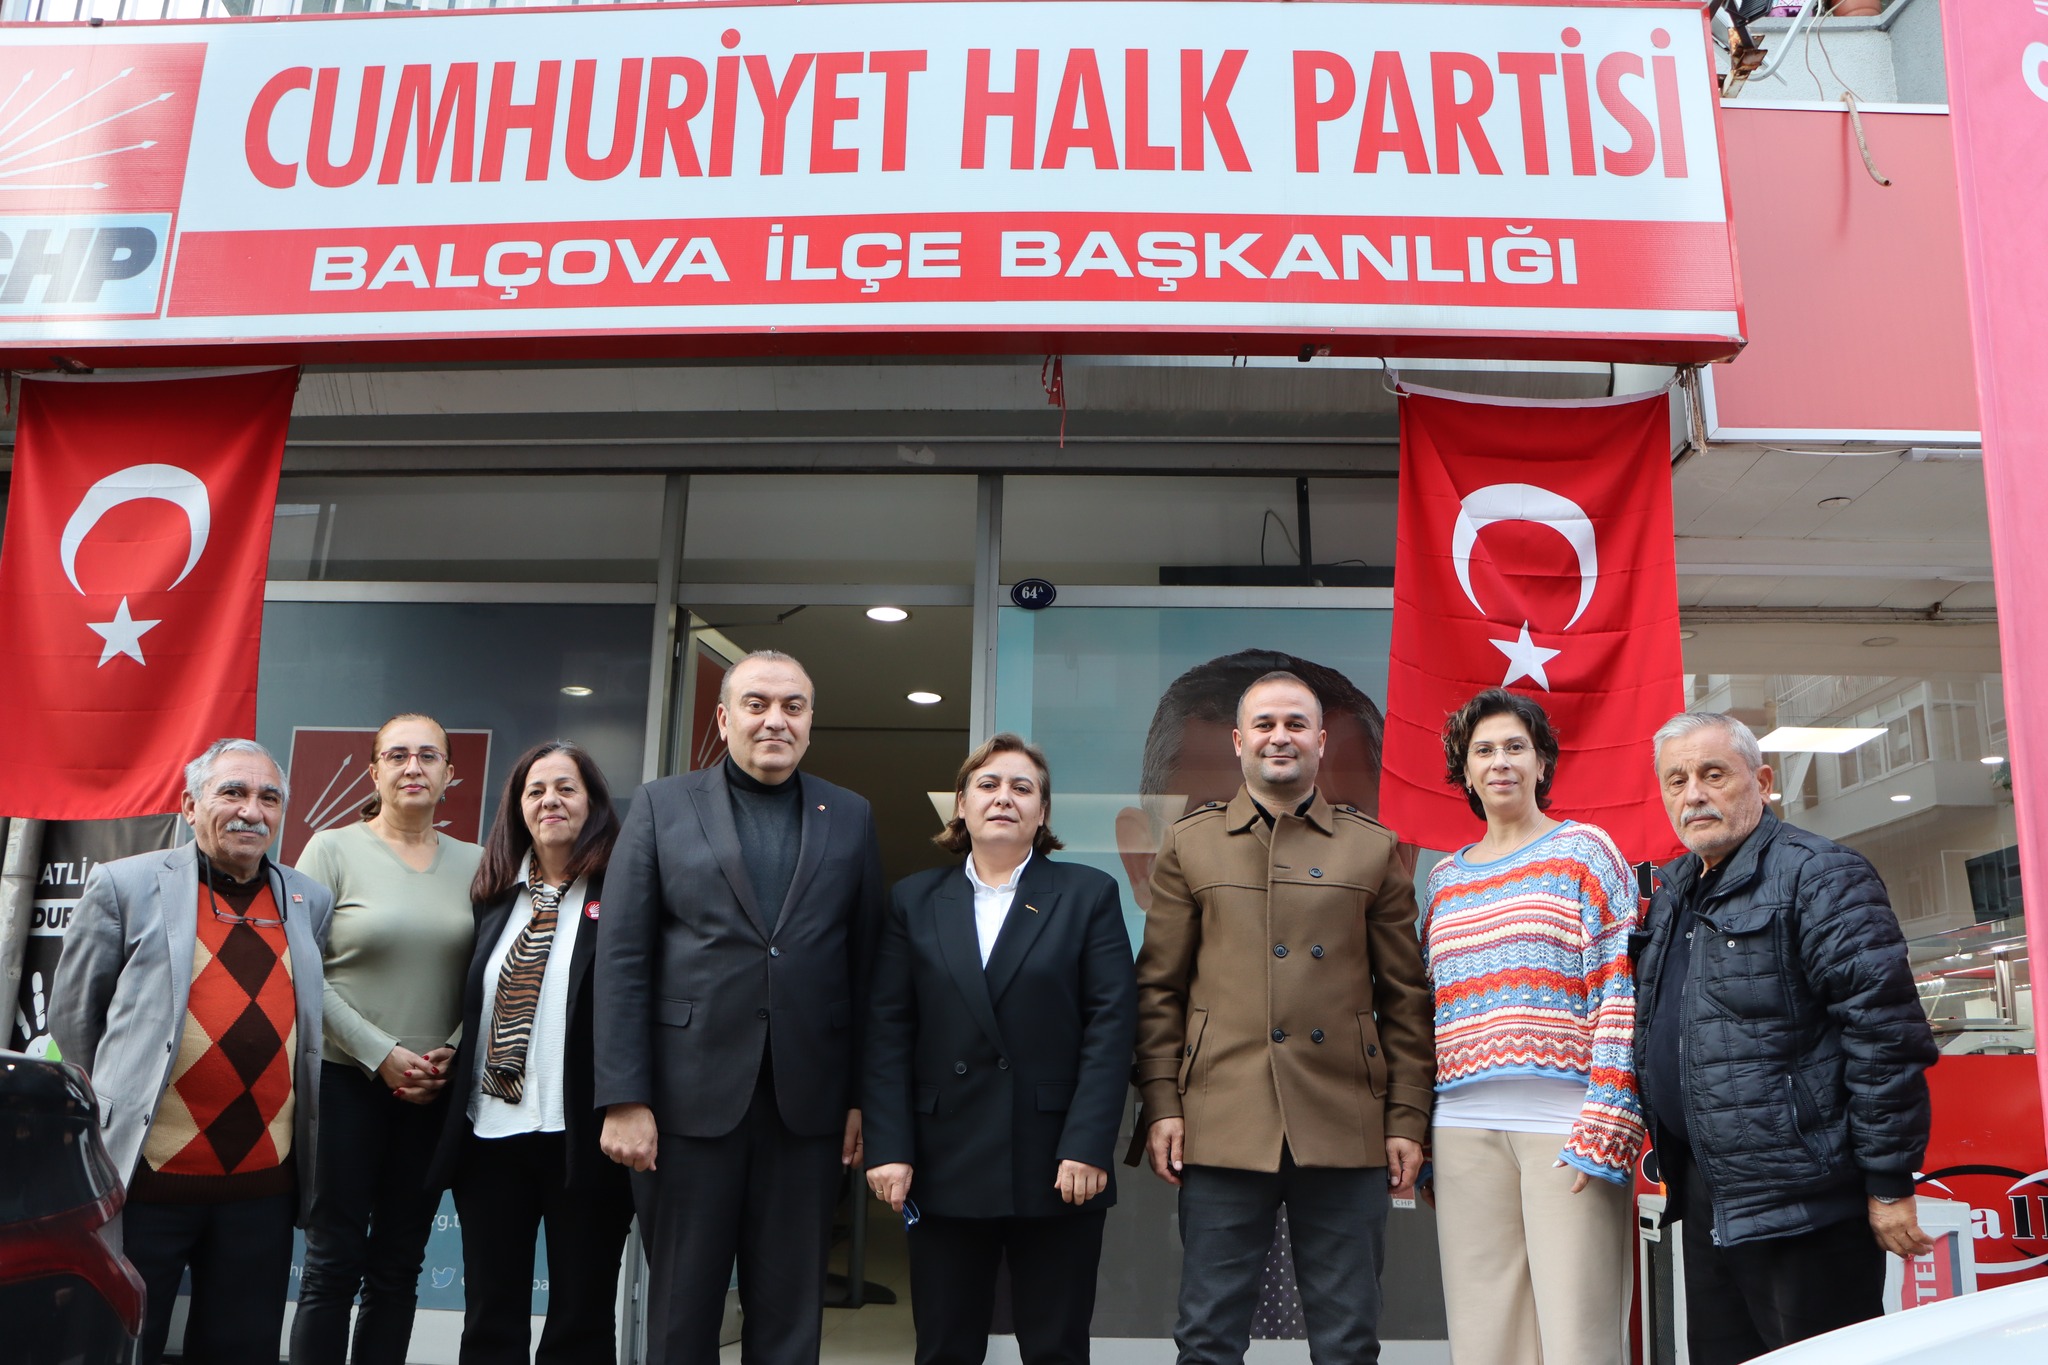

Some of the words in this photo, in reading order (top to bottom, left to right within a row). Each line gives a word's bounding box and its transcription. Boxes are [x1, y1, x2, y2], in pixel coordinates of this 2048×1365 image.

[246, 28, 928, 189] CUMHURİYET
[960, 48, 1253, 173] HALK
[1293, 28, 1688, 178] PARTİSİ
[0, 226, 158, 305] HP
[309, 236, 731, 300] BALÇOVA
[765, 223, 962, 294] İLÇE
[1000, 224, 1579, 293] BAŞKANLIĞI
